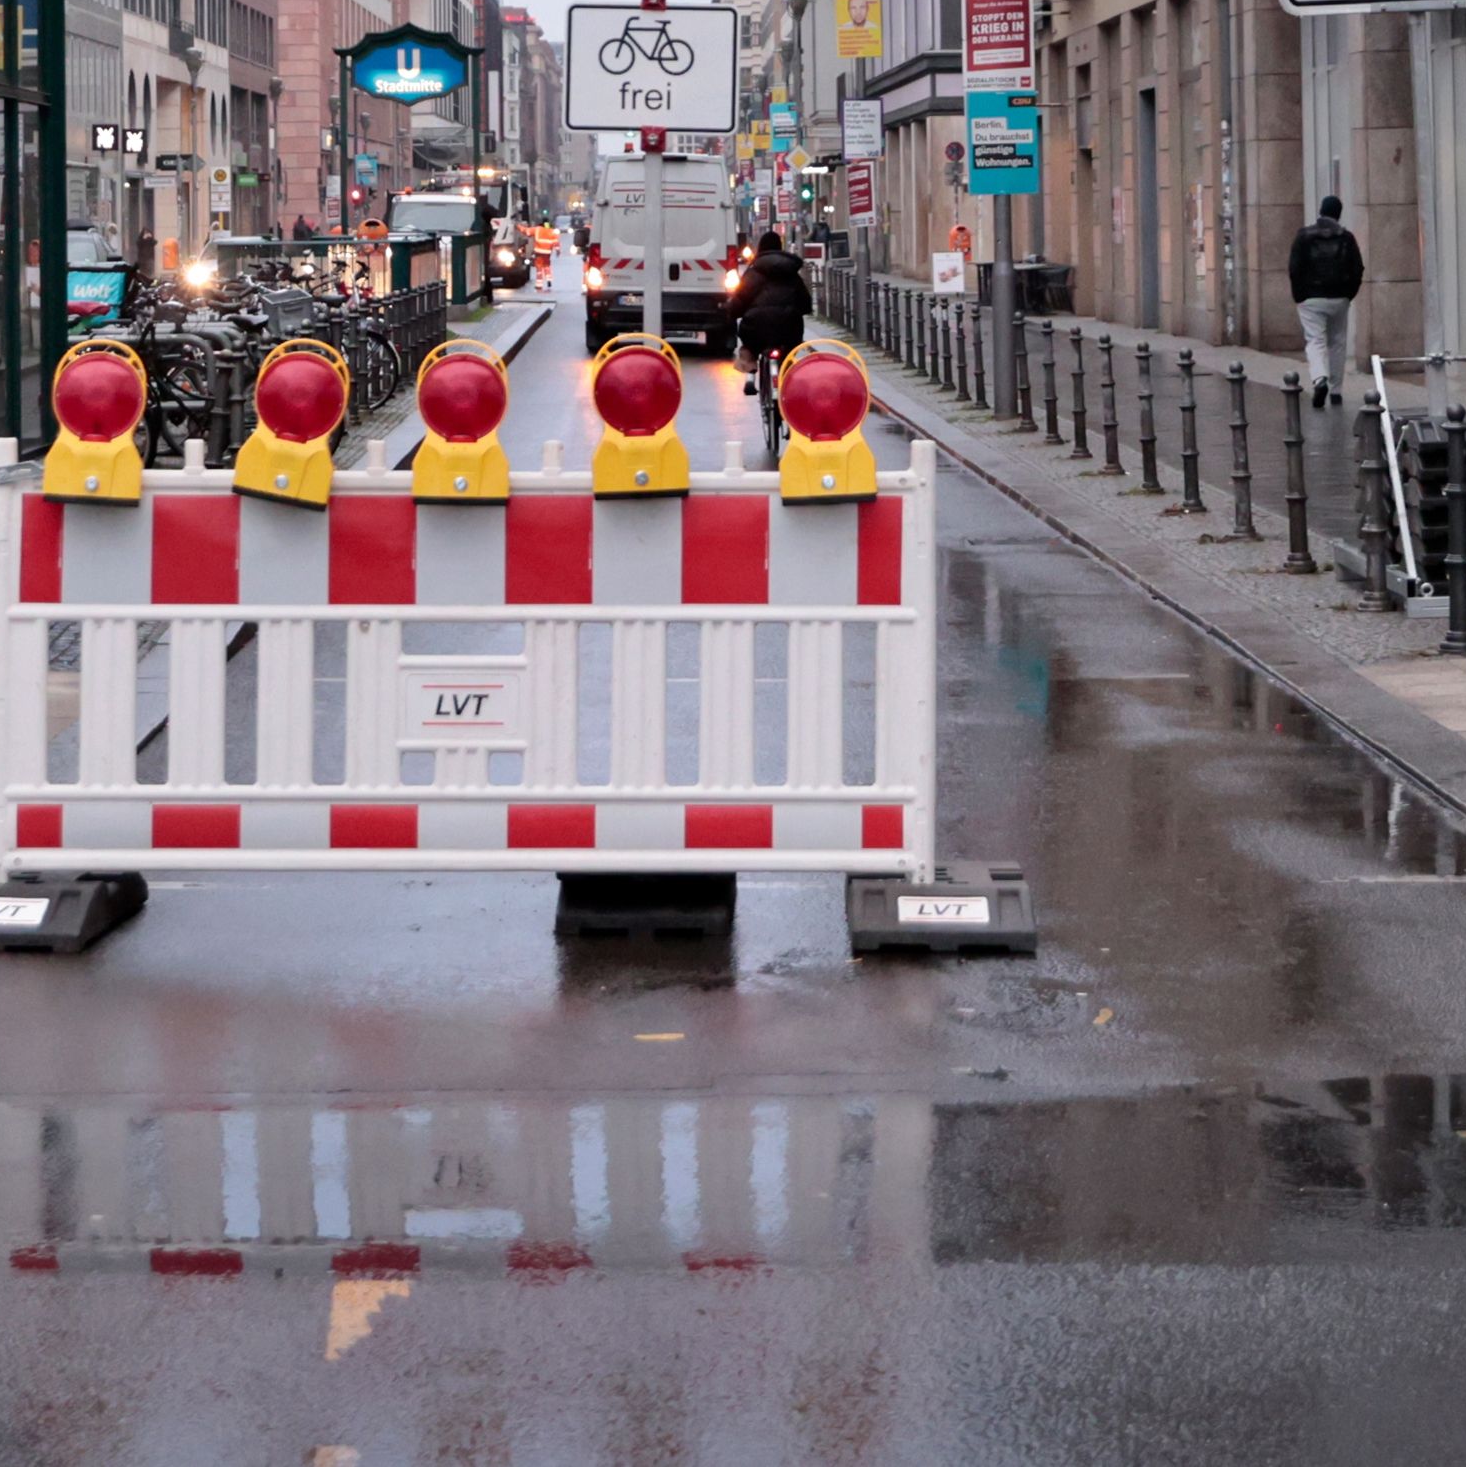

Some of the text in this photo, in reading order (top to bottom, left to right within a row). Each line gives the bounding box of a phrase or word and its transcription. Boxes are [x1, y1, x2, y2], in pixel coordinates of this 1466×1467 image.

[971, 11, 1024, 23] STOPPT DEN
[971, 20, 1025, 35] KRIEG IN
[972, 33, 1025, 45] DER UKRAINE
[396, 48, 421, 80] U
[375, 78, 443, 93] Stadtmitte
[619, 81, 672, 111] frei
[1011, 97, 1032, 106] CDU
[974, 120, 1004, 129] Berlin.
[975, 132, 1030, 141] Du brauchst
[974, 145, 1015, 157] günstige
[975, 157, 1032, 168] Wohnungen.
[435, 694, 489, 717] LVT
[917, 903, 969, 916] LVT
